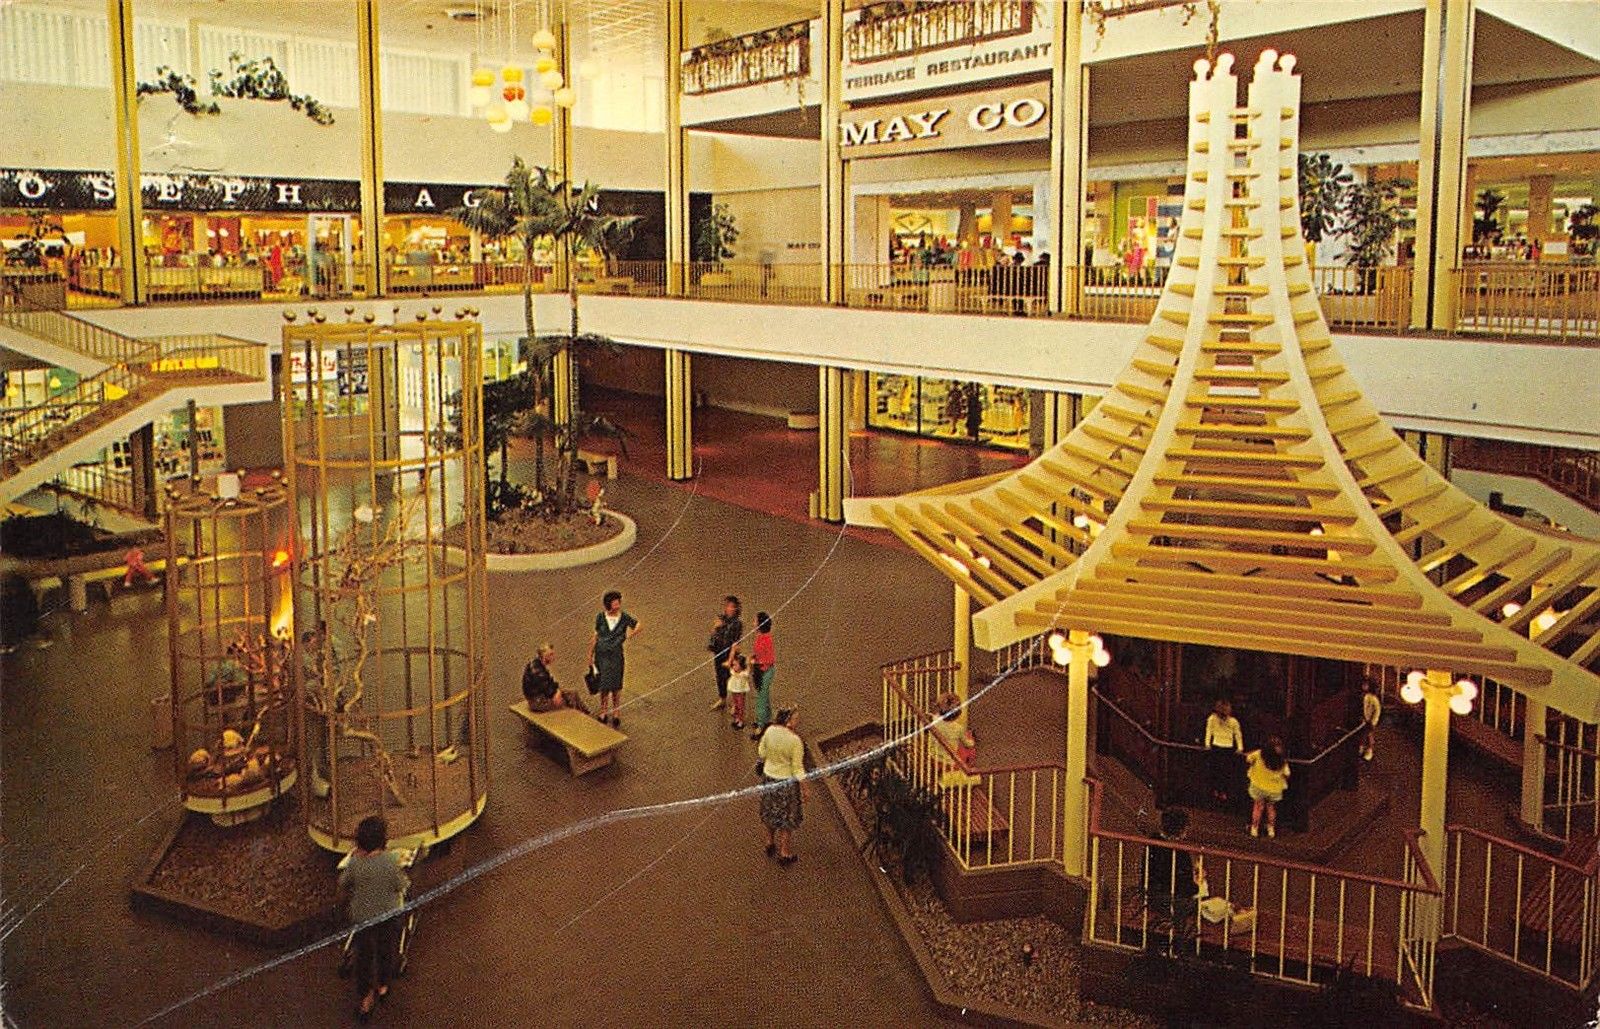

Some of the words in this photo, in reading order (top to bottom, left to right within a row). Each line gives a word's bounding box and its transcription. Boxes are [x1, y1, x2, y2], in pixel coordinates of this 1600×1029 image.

[845, 67, 915, 89] TERRACE
[927, 43, 1052, 77] RESTAURANT
[840, 108, 949, 147] MAY
[968, 97, 1046, 132] CO
